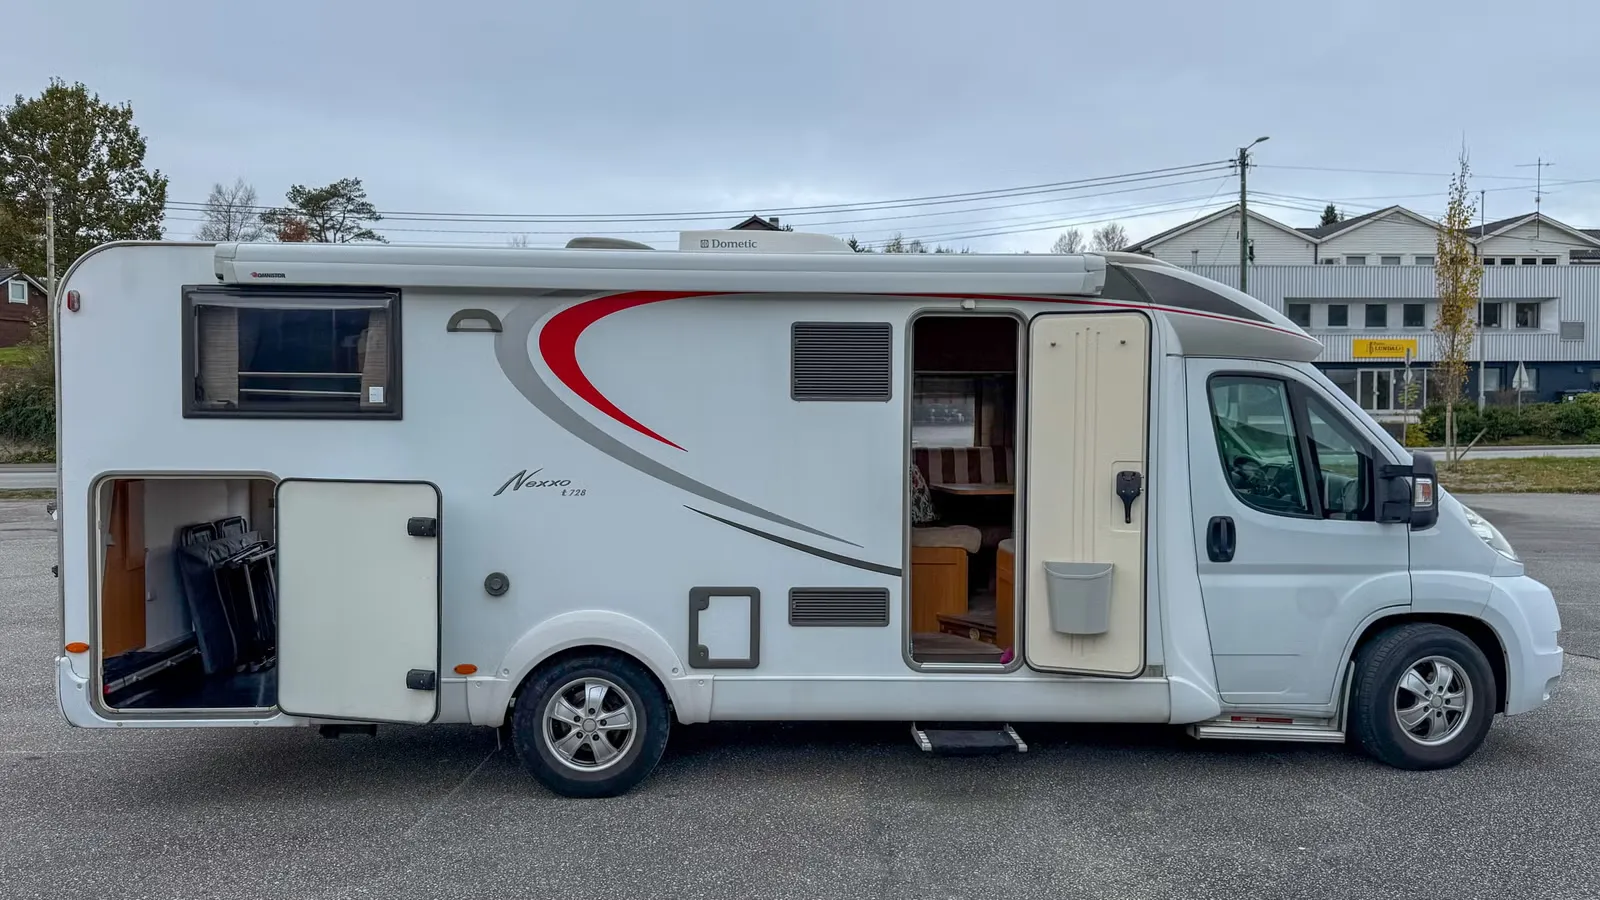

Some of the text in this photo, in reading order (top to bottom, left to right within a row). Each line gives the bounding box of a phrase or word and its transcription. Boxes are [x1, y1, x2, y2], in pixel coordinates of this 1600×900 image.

[711, 239, 758, 249] Dometic
[492, 467, 572, 497] Nexxo
[568, 488, 587, 497] 728
